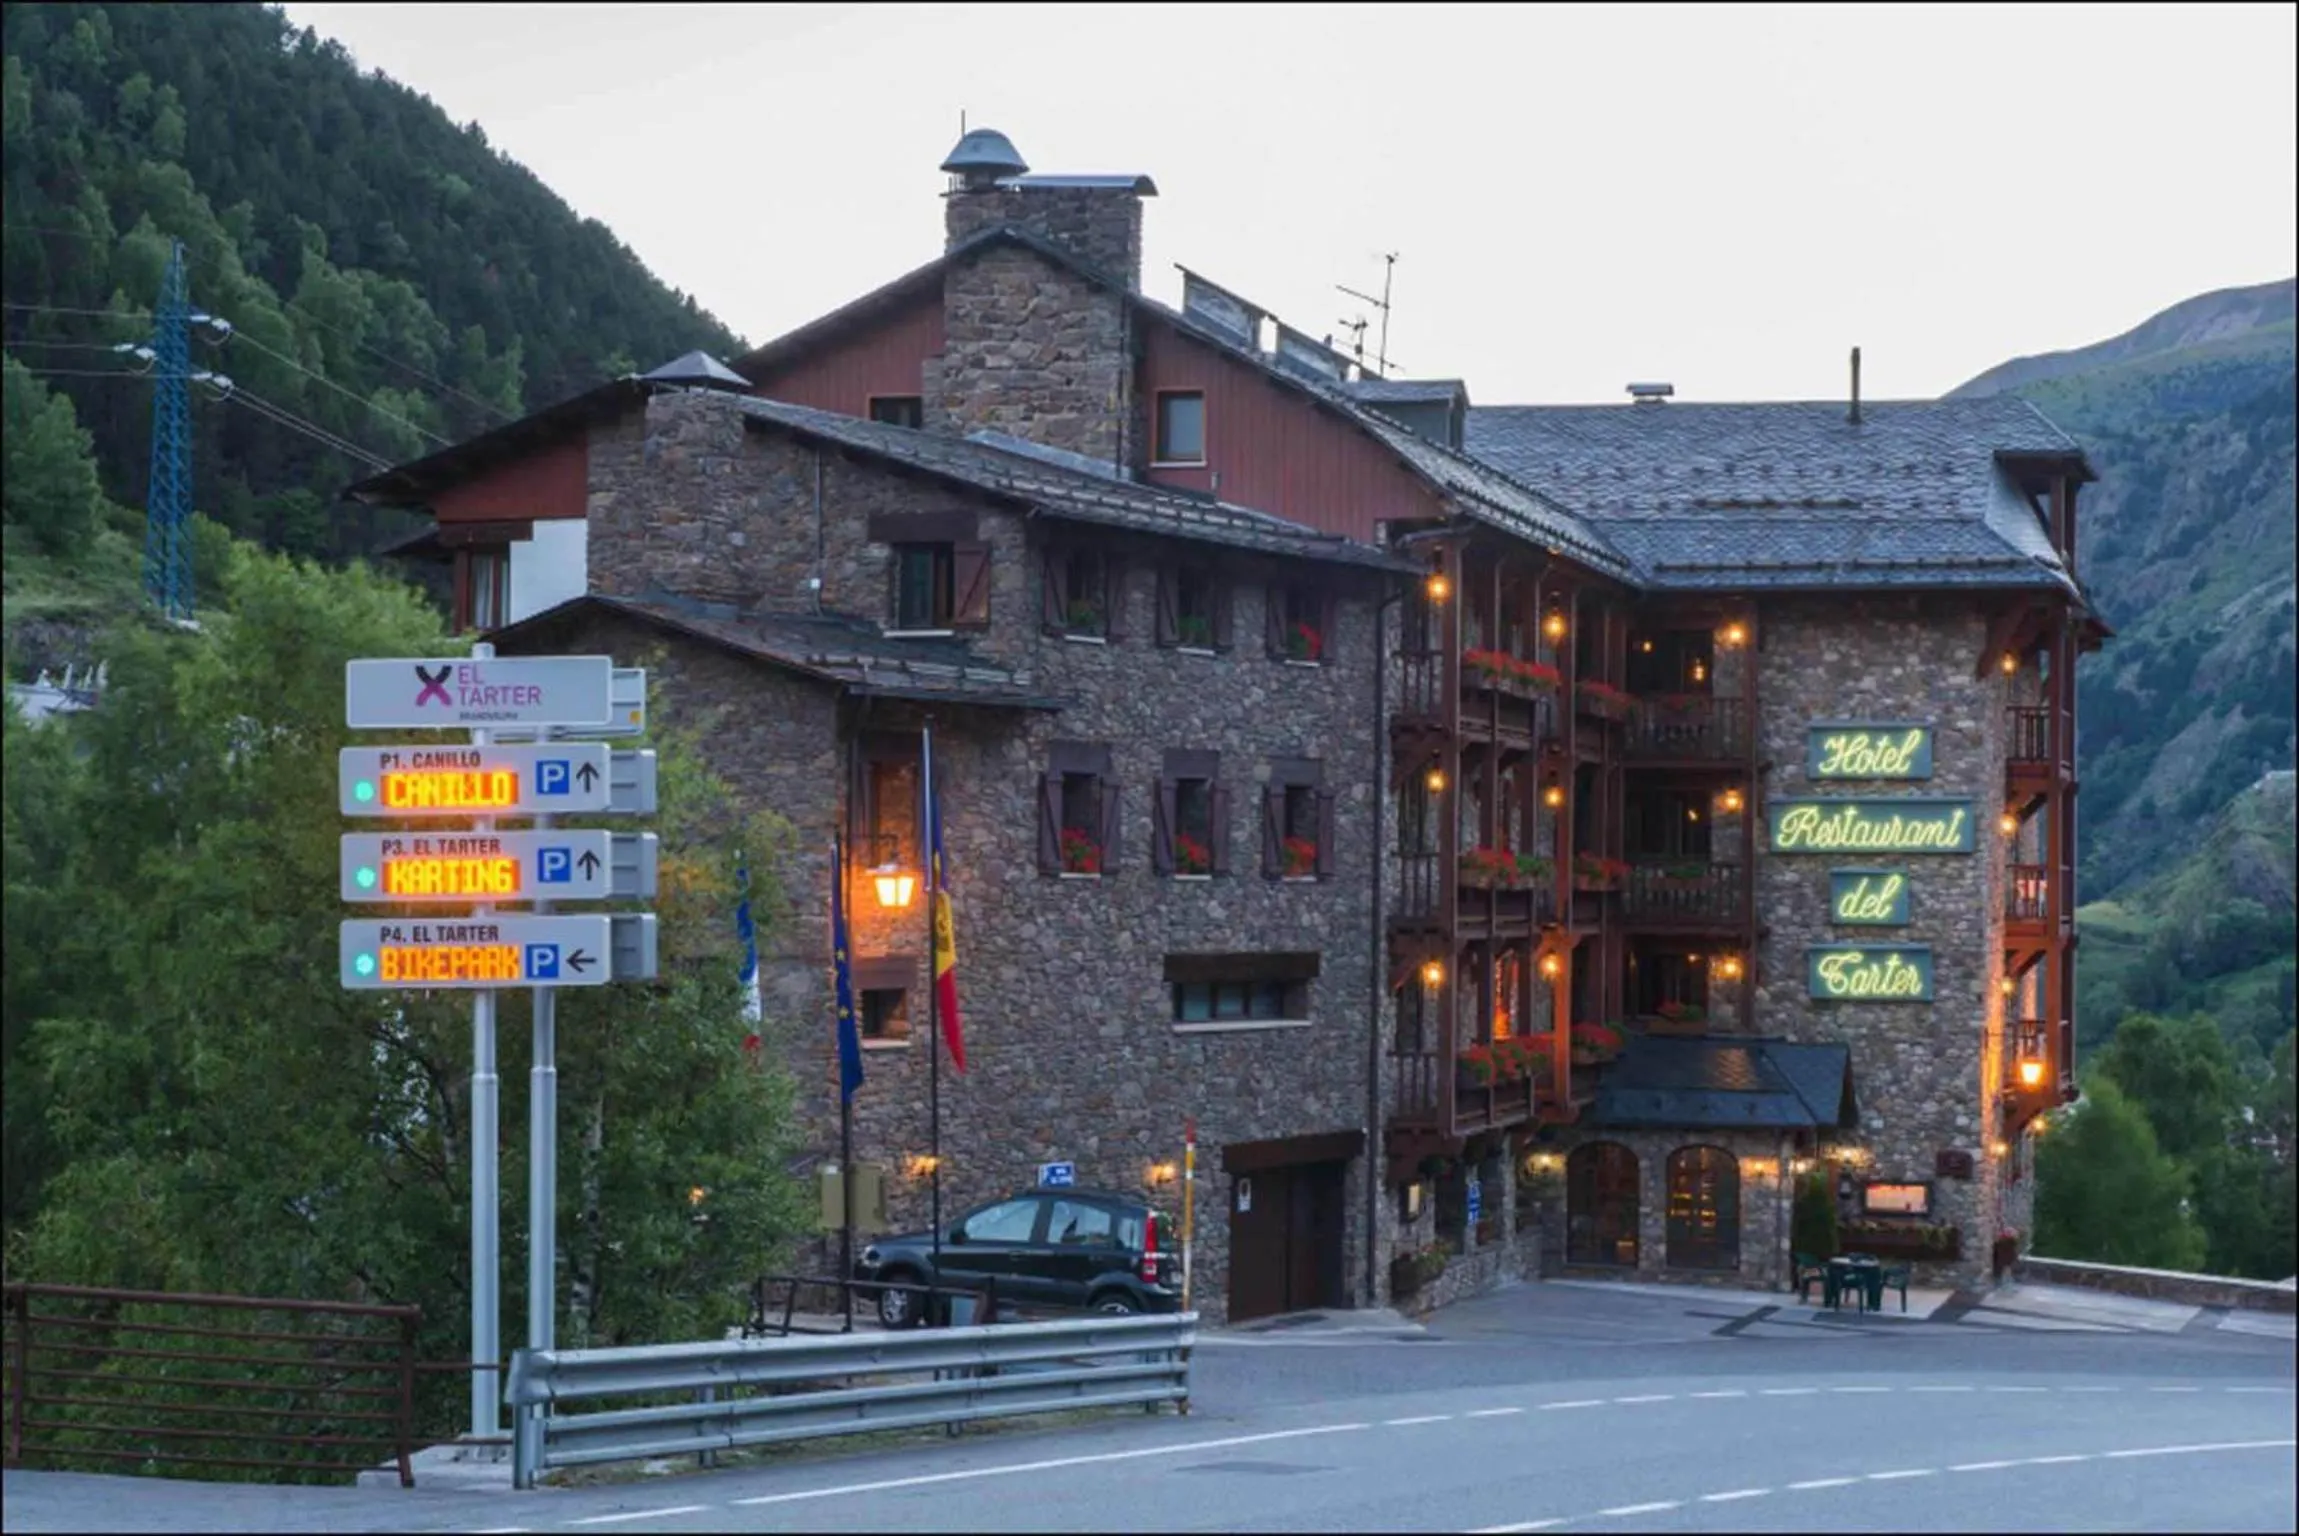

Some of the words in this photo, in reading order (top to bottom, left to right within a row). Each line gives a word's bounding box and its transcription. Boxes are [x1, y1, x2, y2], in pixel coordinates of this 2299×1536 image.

[458, 665, 484, 684] EL
[458, 686, 542, 706] TARTER
[412, 752, 481, 767] CANILLO
[1818, 729, 1921, 774] Hotel
[387, 772, 512, 807] CANILLO
[542, 765, 565, 792] P
[1776, 804, 1965, 847] Restaurant
[414, 840, 432, 855] EL
[440, 839, 500, 855] TARTER
[390, 859, 514, 896] KARTING
[543, 851, 566, 880] P
[1838, 873, 1902, 918] del
[413, 926, 431, 941] EL
[437, 925, 499, 941] TARTER
[379, 946, 520, 981] BIKEPARK
[532, 947, 555, 976] P
[1818, 952, 1922, 994] Tarter
